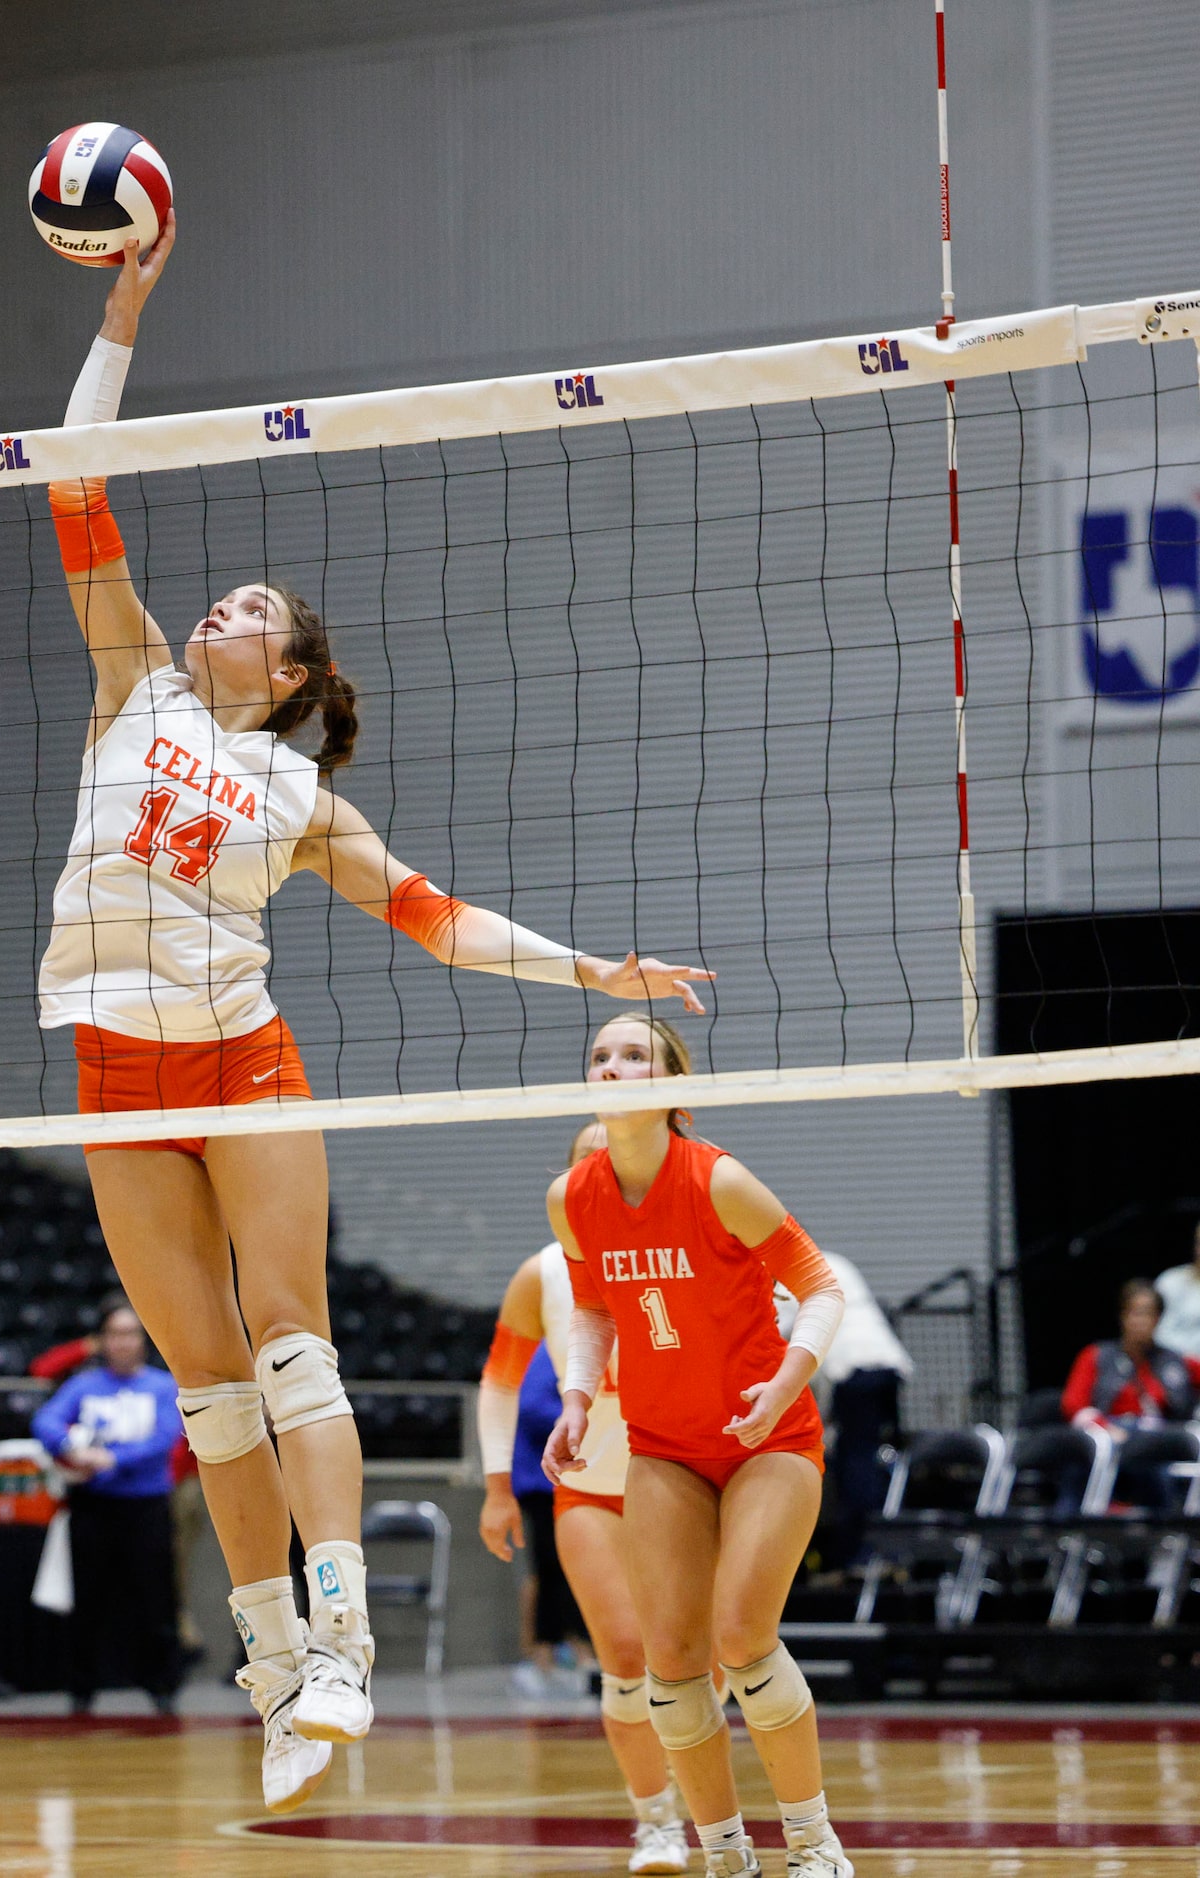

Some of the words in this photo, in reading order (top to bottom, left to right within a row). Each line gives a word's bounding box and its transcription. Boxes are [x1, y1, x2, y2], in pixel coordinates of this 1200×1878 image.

[49, 232, 108, 252] Baden
[144, 736, 255, 822] CELINA
[124, 786, 232, 887] 14
[602, 1248, 695, 1282] CELINA
[639, 1287, 681, 1350] 1
